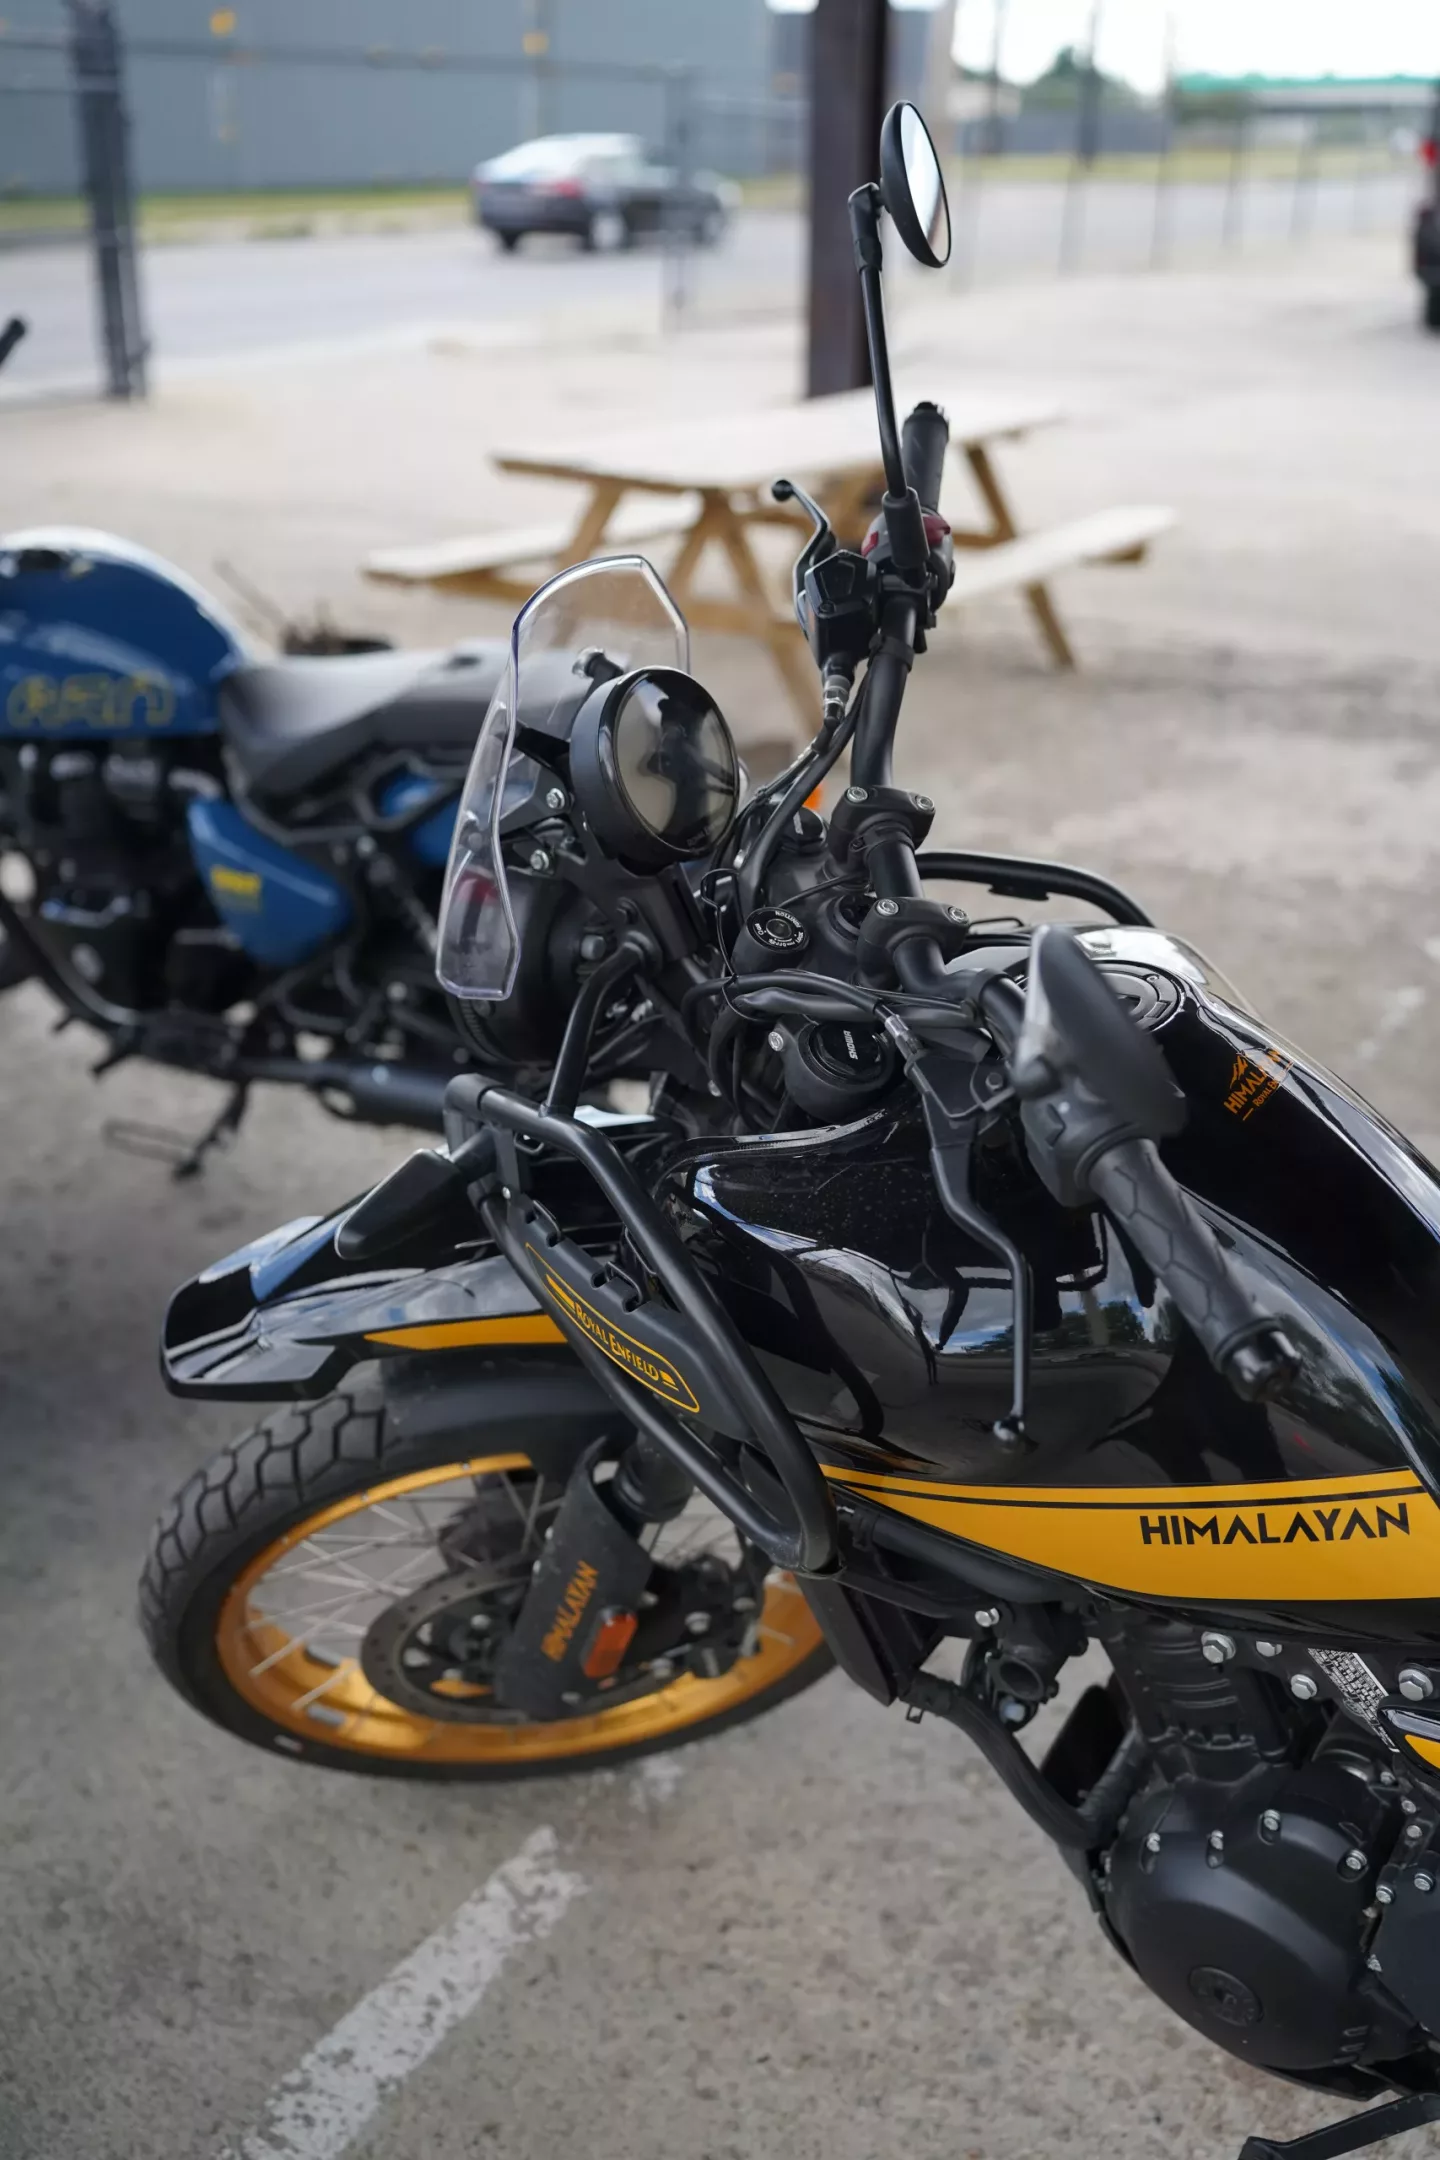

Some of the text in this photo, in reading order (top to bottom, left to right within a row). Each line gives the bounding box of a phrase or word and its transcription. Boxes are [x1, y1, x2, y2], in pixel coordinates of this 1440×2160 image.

[843, 1030, 859, 1060] SHOWA
[1224, 1048, 1279, 1114] HIMALAAN
[1252, 1087, 1273, 1107] ROYAL
[575, 1302, 659, 1381] ROYAL ENFIELD
[1139, 1502, 1410, 1545] HIMALAYAN
